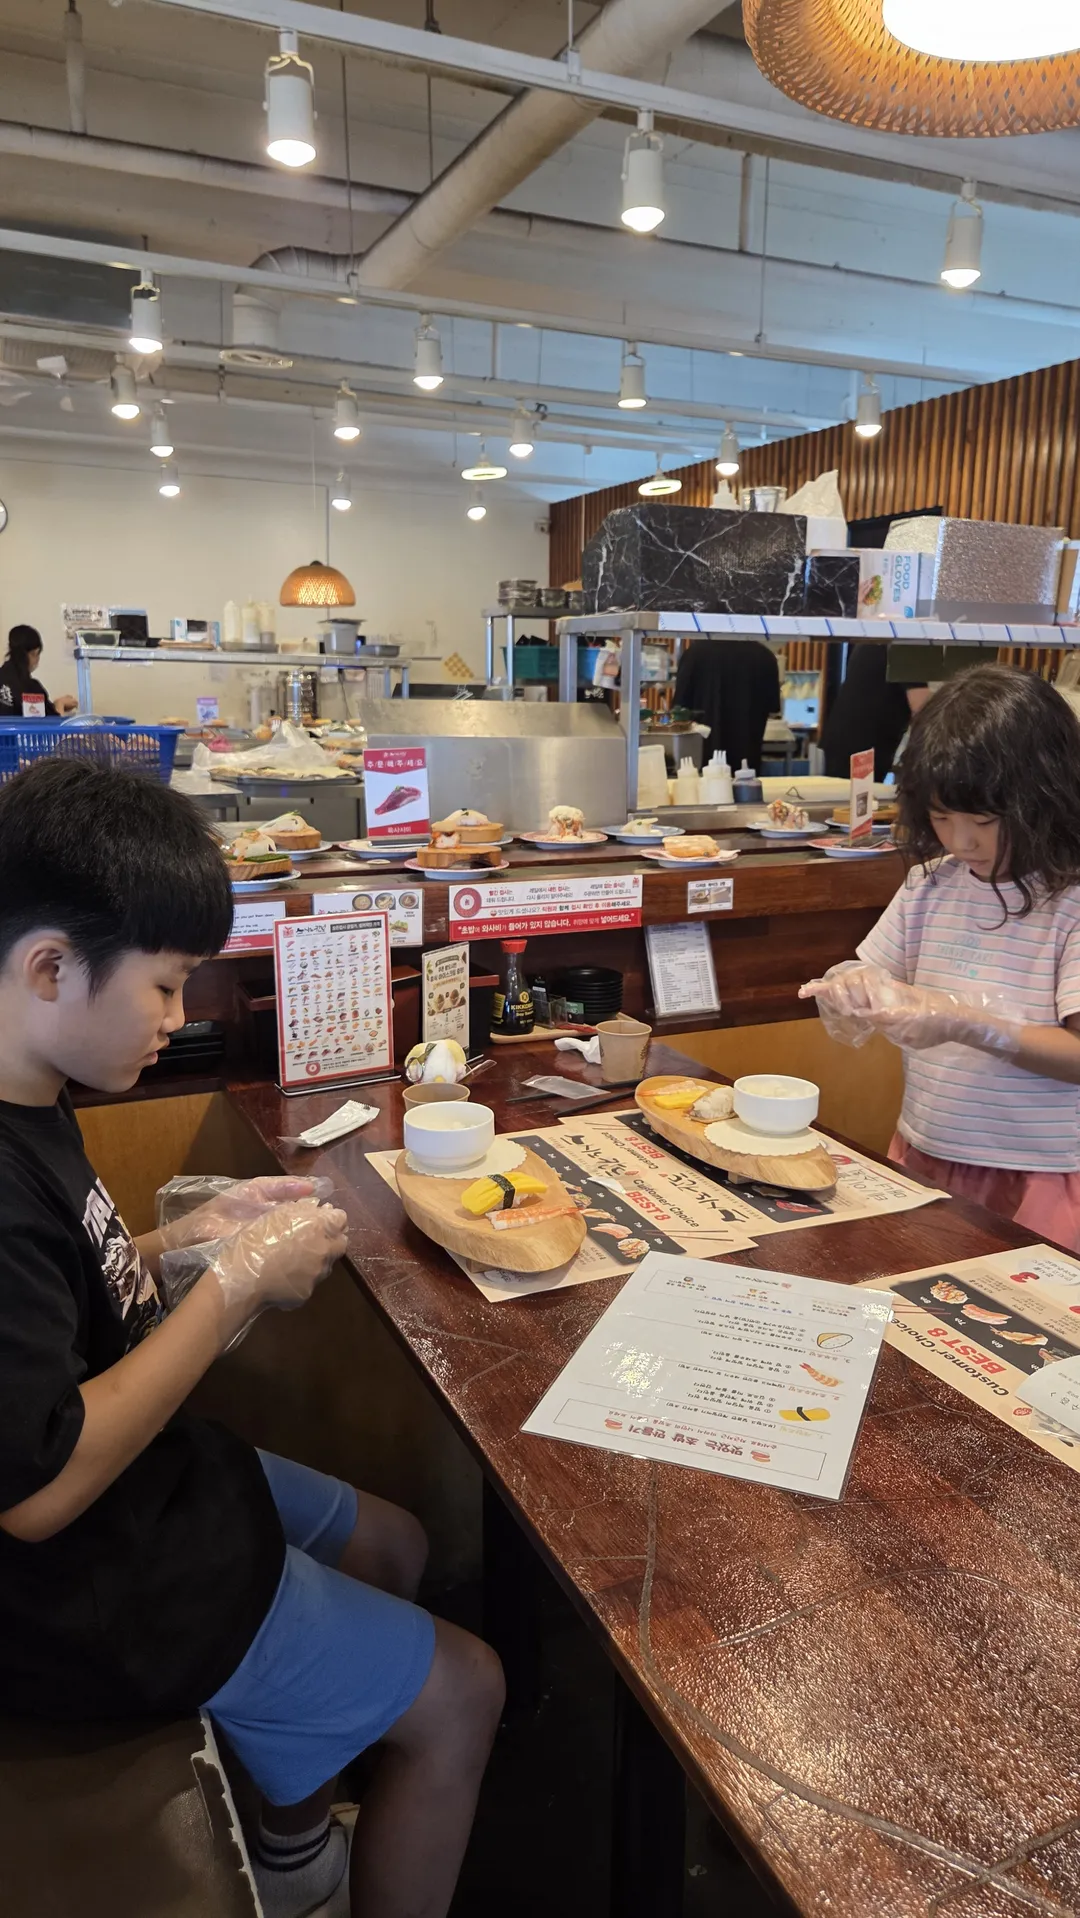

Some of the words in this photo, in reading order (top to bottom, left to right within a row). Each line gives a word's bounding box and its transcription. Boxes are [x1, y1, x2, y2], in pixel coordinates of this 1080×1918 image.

[893, 555, 903, 603] GLOVES
[902, 556, 911, 590] FOOD
[497, 907, 514, 916] 맛있게
[515, 905, 540, 915] 드셨나요?
[582, 902, 593, 910] 확인
[594, 901, 599, 909] 후
[481, 922, 506, 933] 와사비가
[507, 920, 528, 931] 들어가
[529, 919, 542, 929] 있지
[543, 916, 571, 928] 않습니다.
[631, 1139, 666, 1159] BEST
[625, 1190, 663, 1216] BEST
[657, 1213, 672, 1222] 8
[669, 1207, 700, 1228] Choice
[1009, 1271, 1040, 1283] 3
[891, 1318, 936, 1348] Choice
[926, 1327, 949, 1340] 8
[940, 1336, 1007, 1374] BEST
[717, 1391, 738, 1401] 계란을
[738, 1396, 754, 1404] 위에
[746, 1404, 762, 1412] 밥을
[625, 1421, 669, 1440] 만들기
[672, 1422, 695, 1433] 나만의
[669, 1431, 701, 1447] 초밥
[718, 1432, 748, 1444] 차근차근
[748, 1438, 778, 1451] 순서대로
[701, 1438, 746, 1457] 맛있는
